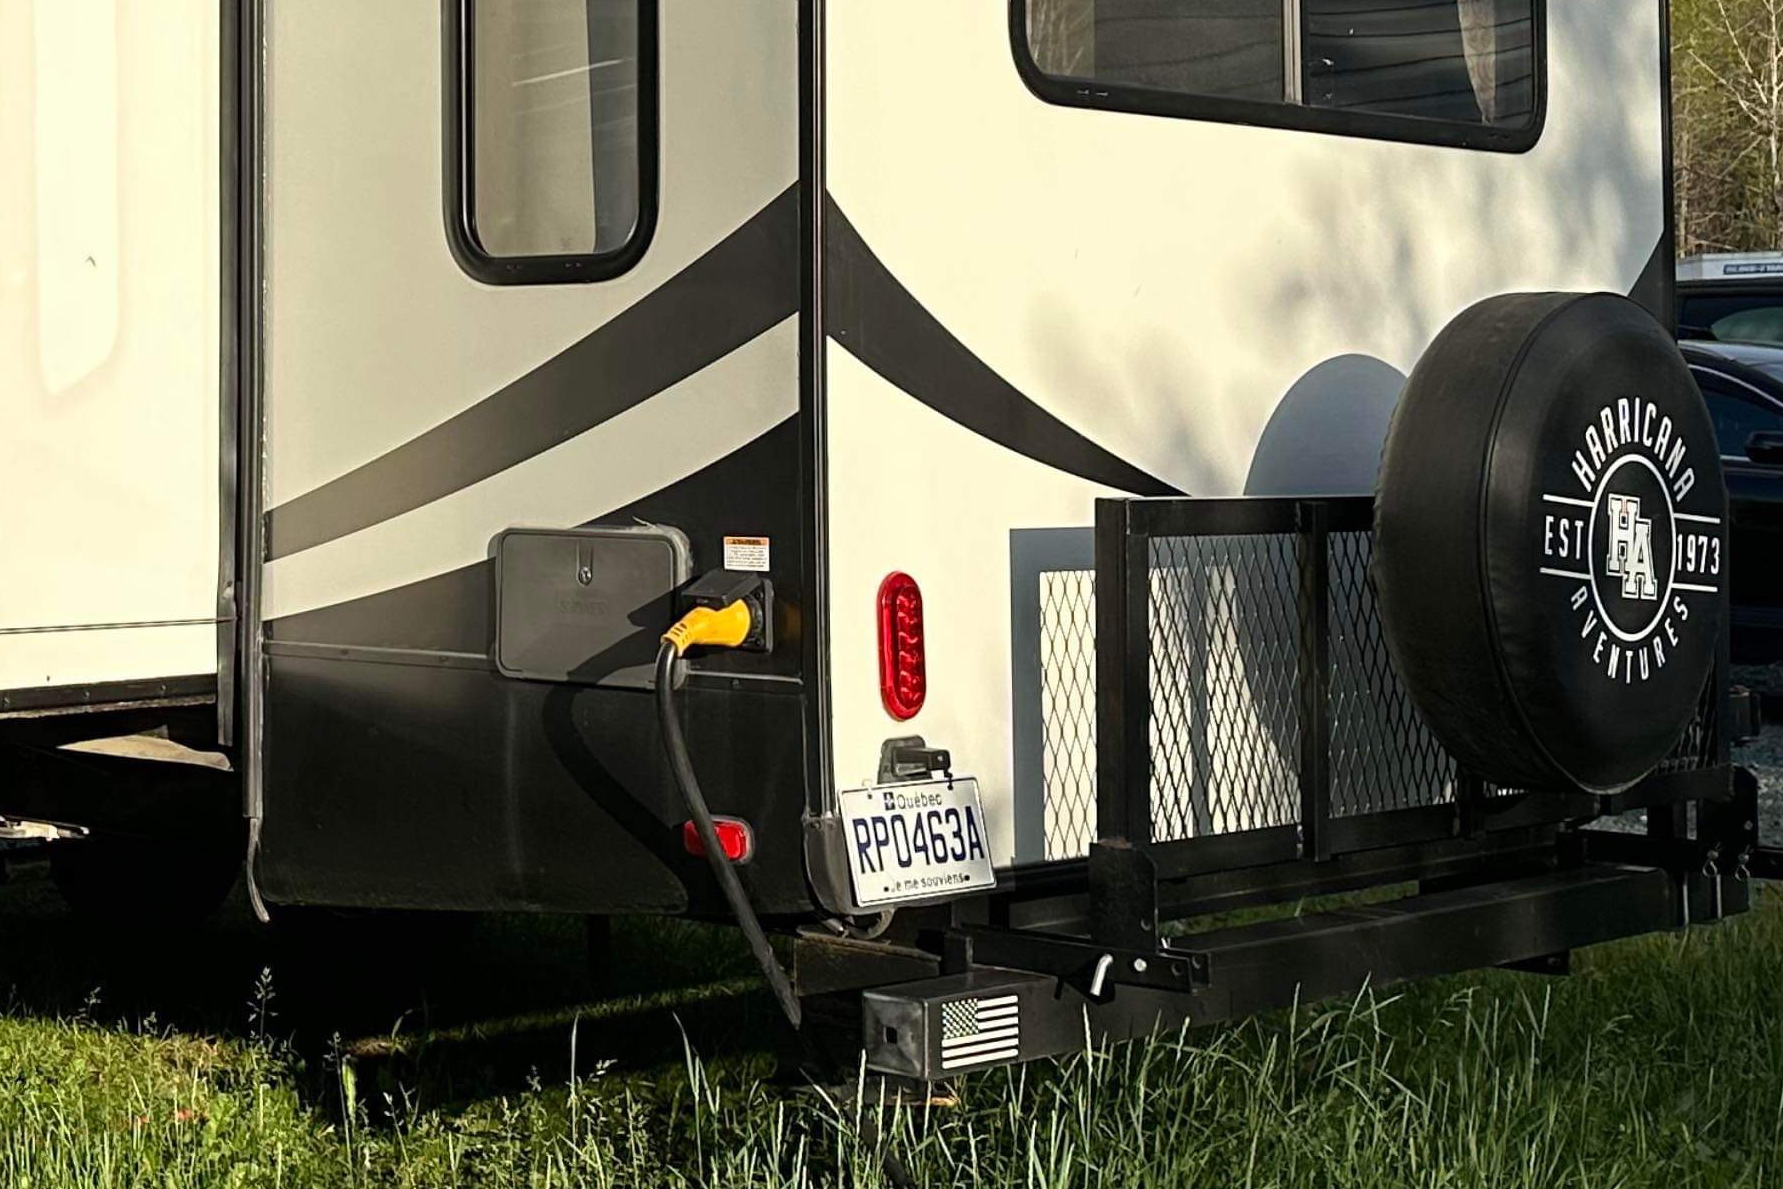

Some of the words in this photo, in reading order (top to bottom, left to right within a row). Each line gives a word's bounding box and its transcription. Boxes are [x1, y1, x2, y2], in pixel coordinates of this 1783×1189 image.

[1571, 397, 1695, 503] HARRICANA
[1544, 515, 1584, 560] EST
[1677, 534, 1721, 575] 1973
[1571, 586, 1688, 684] AVENTURES
[852, 805, 985, 875] RP0463A
[920, 872, 964, 888] souviens
